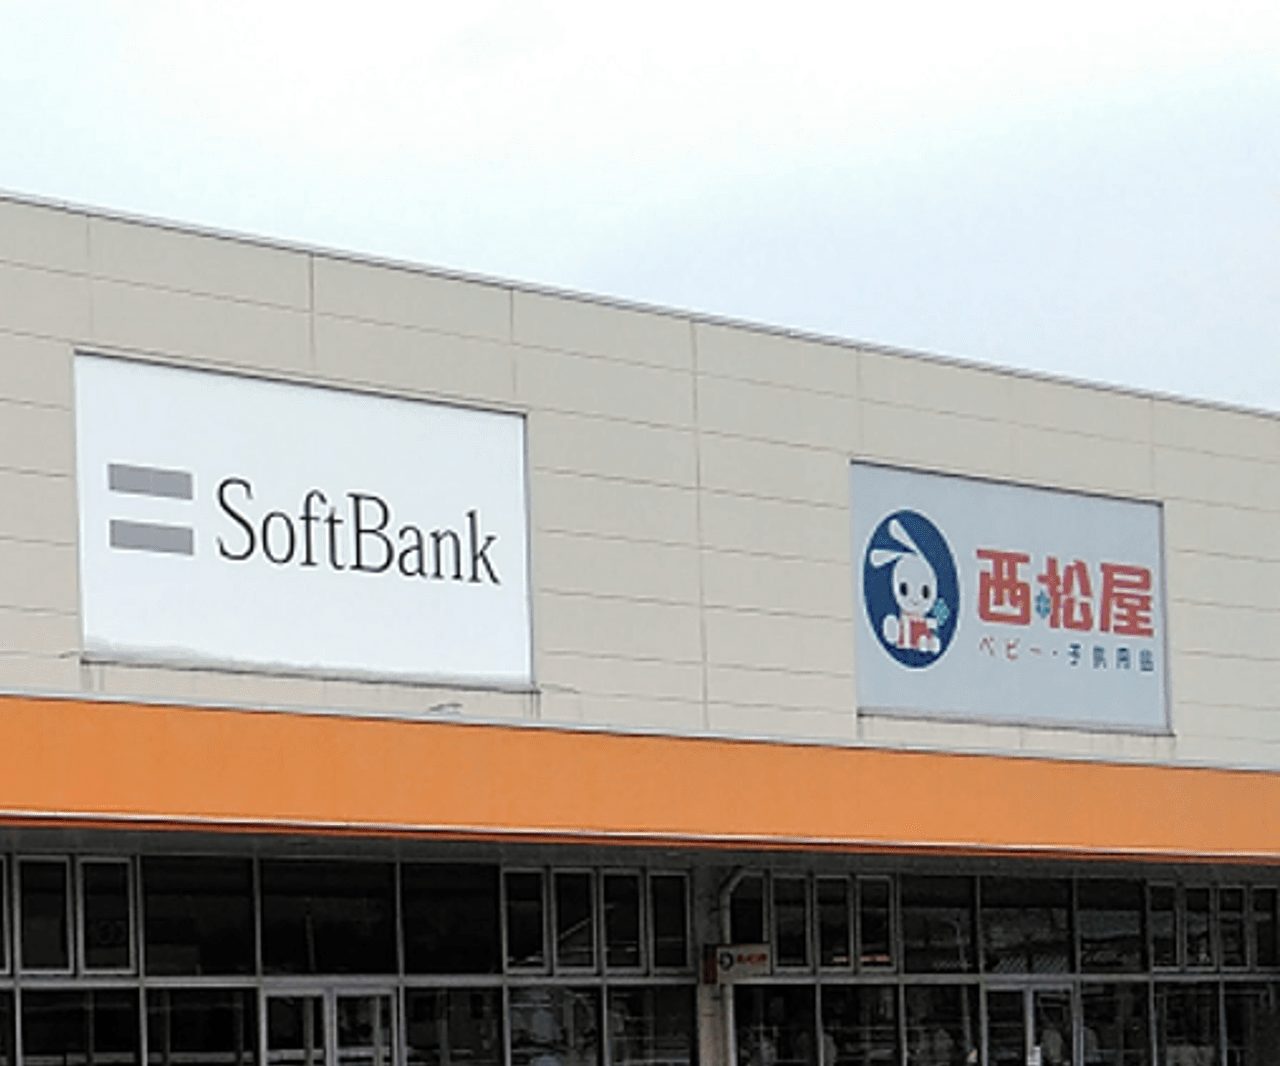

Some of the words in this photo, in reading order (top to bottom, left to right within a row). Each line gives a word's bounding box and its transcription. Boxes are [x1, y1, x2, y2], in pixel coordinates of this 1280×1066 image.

[216, 477, 501, 585] SoftBank
[975, 548, 1155, 638] 西松屋
